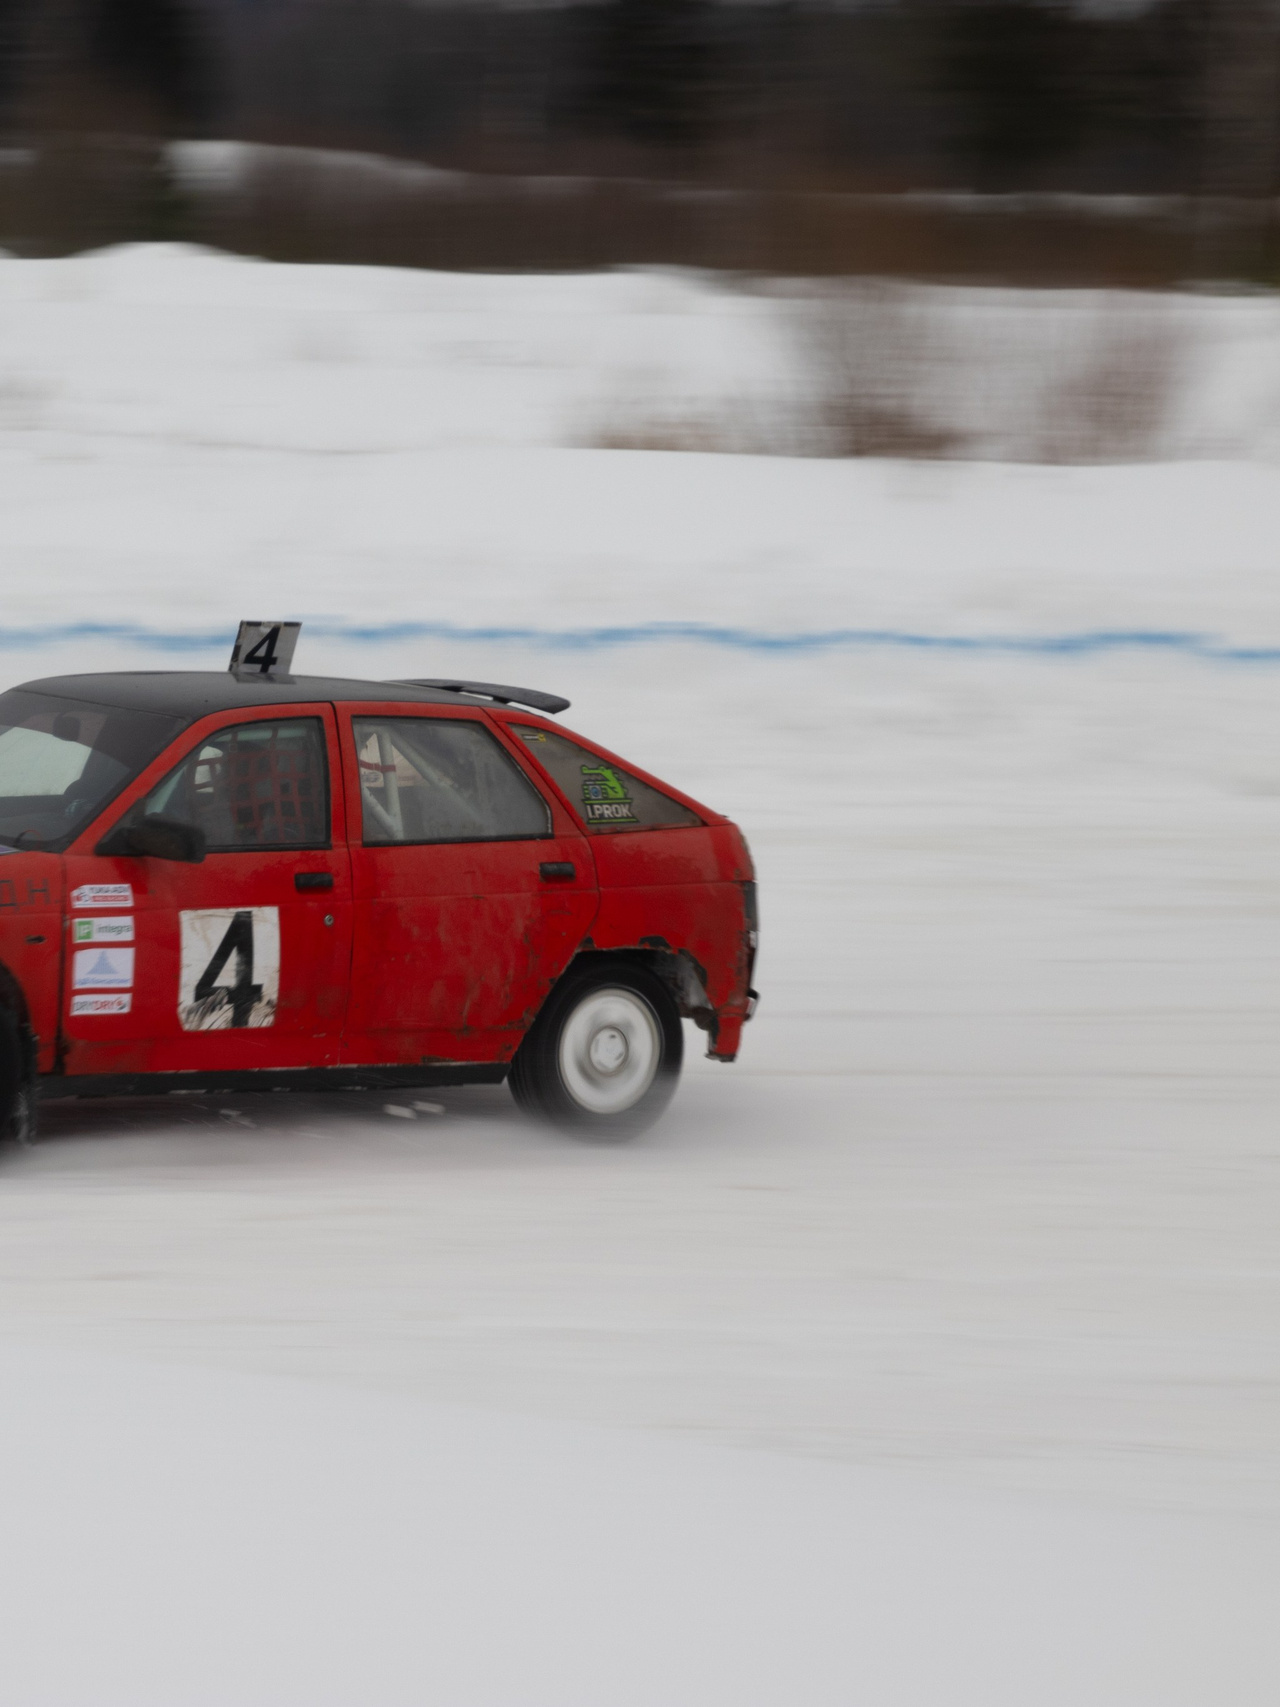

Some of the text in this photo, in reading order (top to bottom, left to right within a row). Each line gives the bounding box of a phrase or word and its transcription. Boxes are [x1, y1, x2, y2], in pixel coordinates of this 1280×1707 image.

[243, 624, 280, 673] 4
[97, 924, 132, 936] integra
[194, 910, 264, 1028] 4
